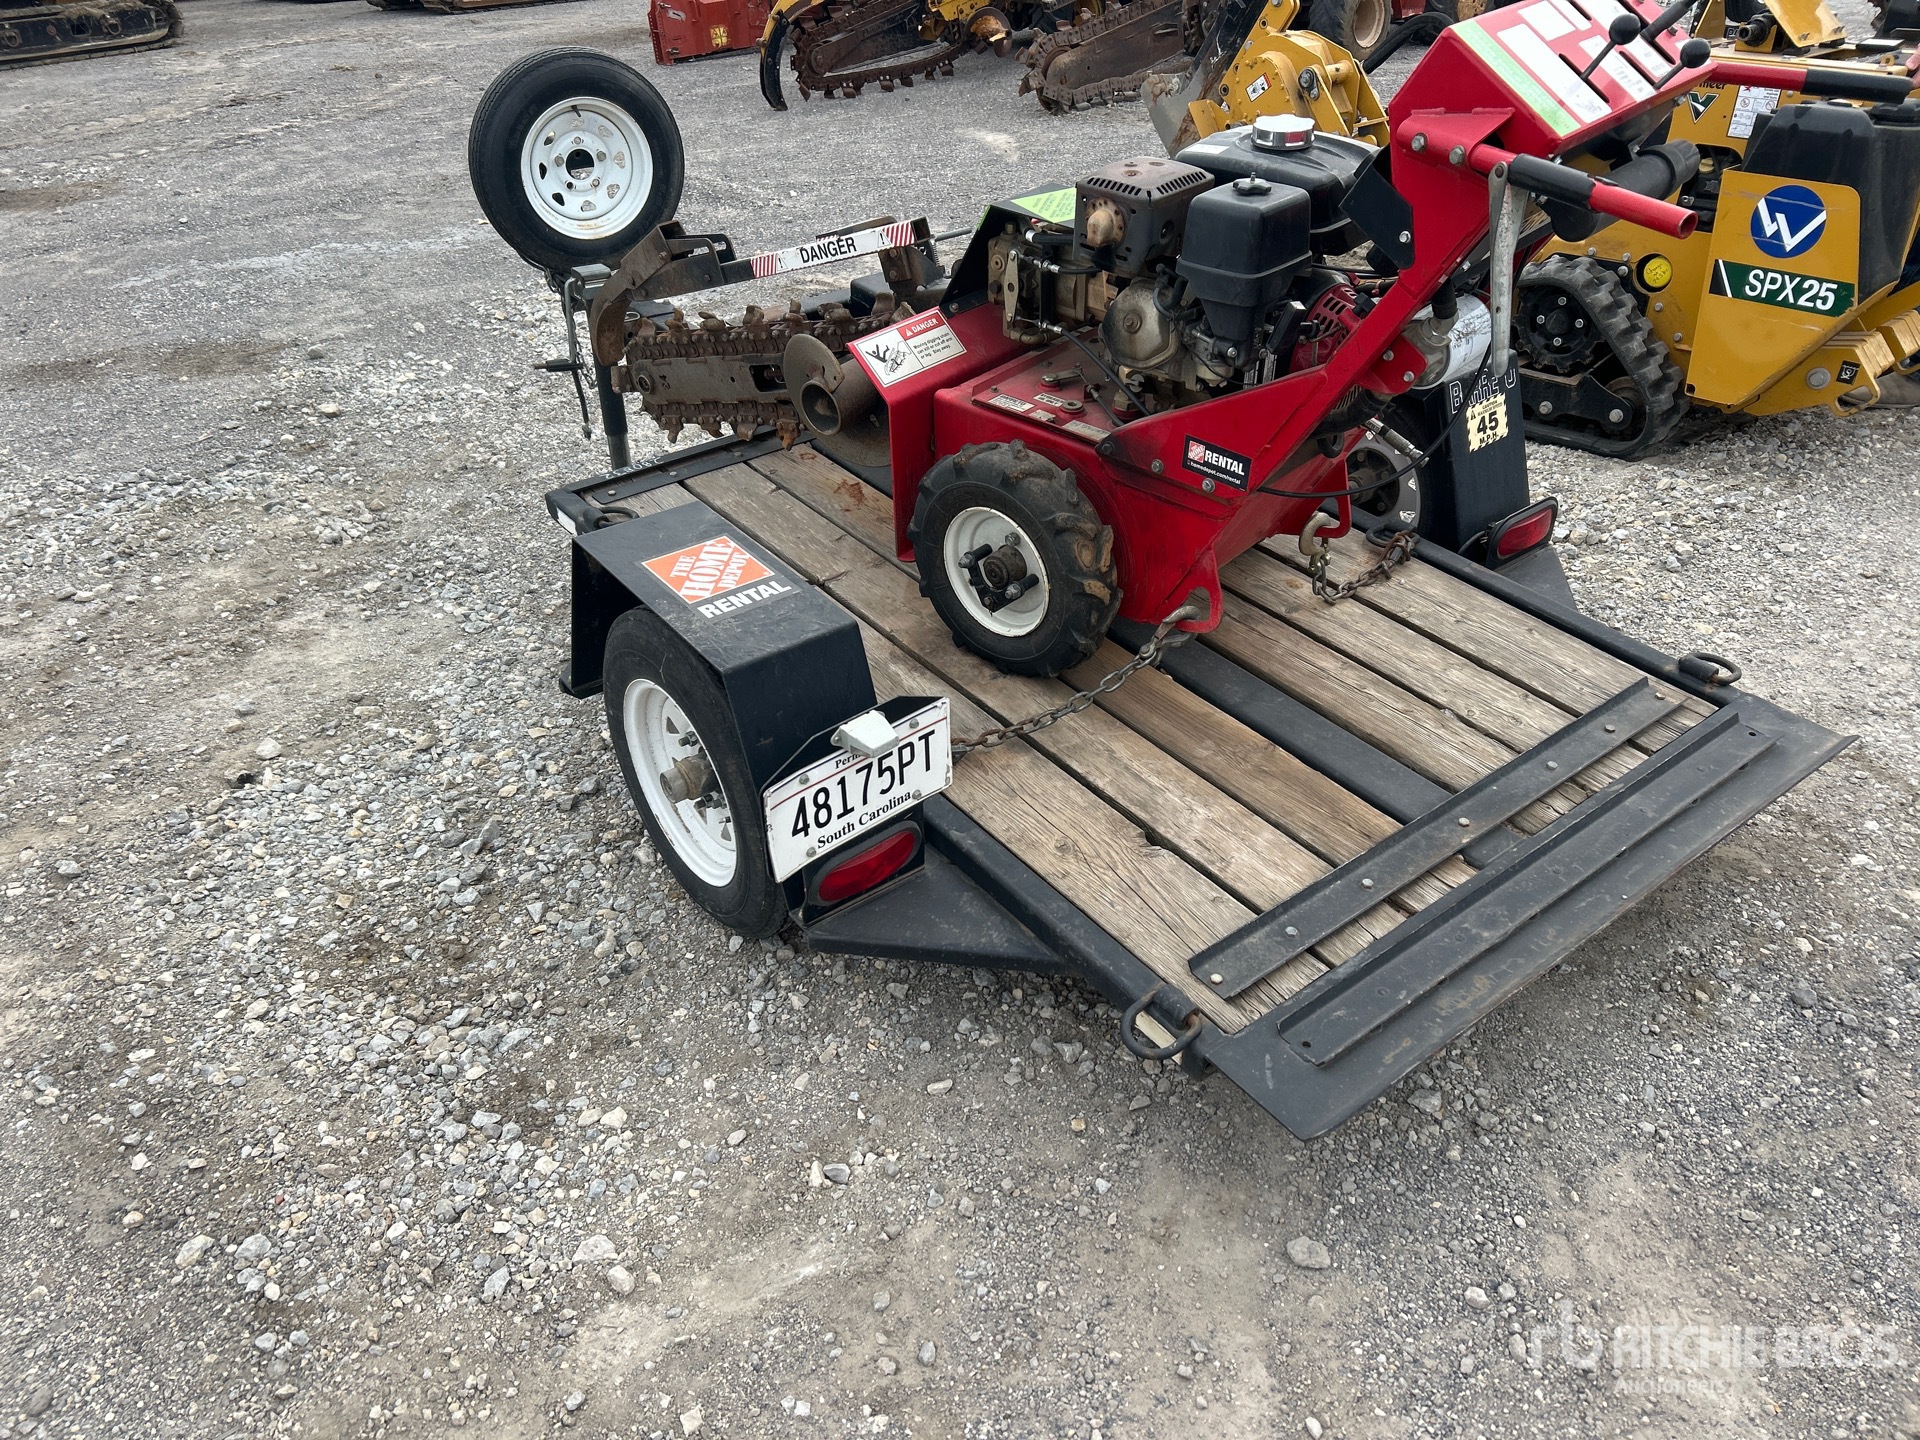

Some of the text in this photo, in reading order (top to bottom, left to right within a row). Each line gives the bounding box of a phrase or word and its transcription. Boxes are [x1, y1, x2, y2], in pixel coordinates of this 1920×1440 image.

[799, 236, 858, 264] DANGER
[911, 318, 939, 334] DANGER
[1476, 410, 1499, 435] 45
[1479, 432, 1499, 444] M.P.H.
[1190, 461, 1241, 485] homedepot.com/rental
[1204, 449, 1245, 476] RENTAL
[670, 554, 696, 578] THE
[680, 539, 735, 600] HOME
[717, 551, 751, 590] DEPOT
[697, 579, 792, 619] RENTAL
[791, 729, 937, 839] 48175PT
[816, 789, 913, 851] South Carolina
